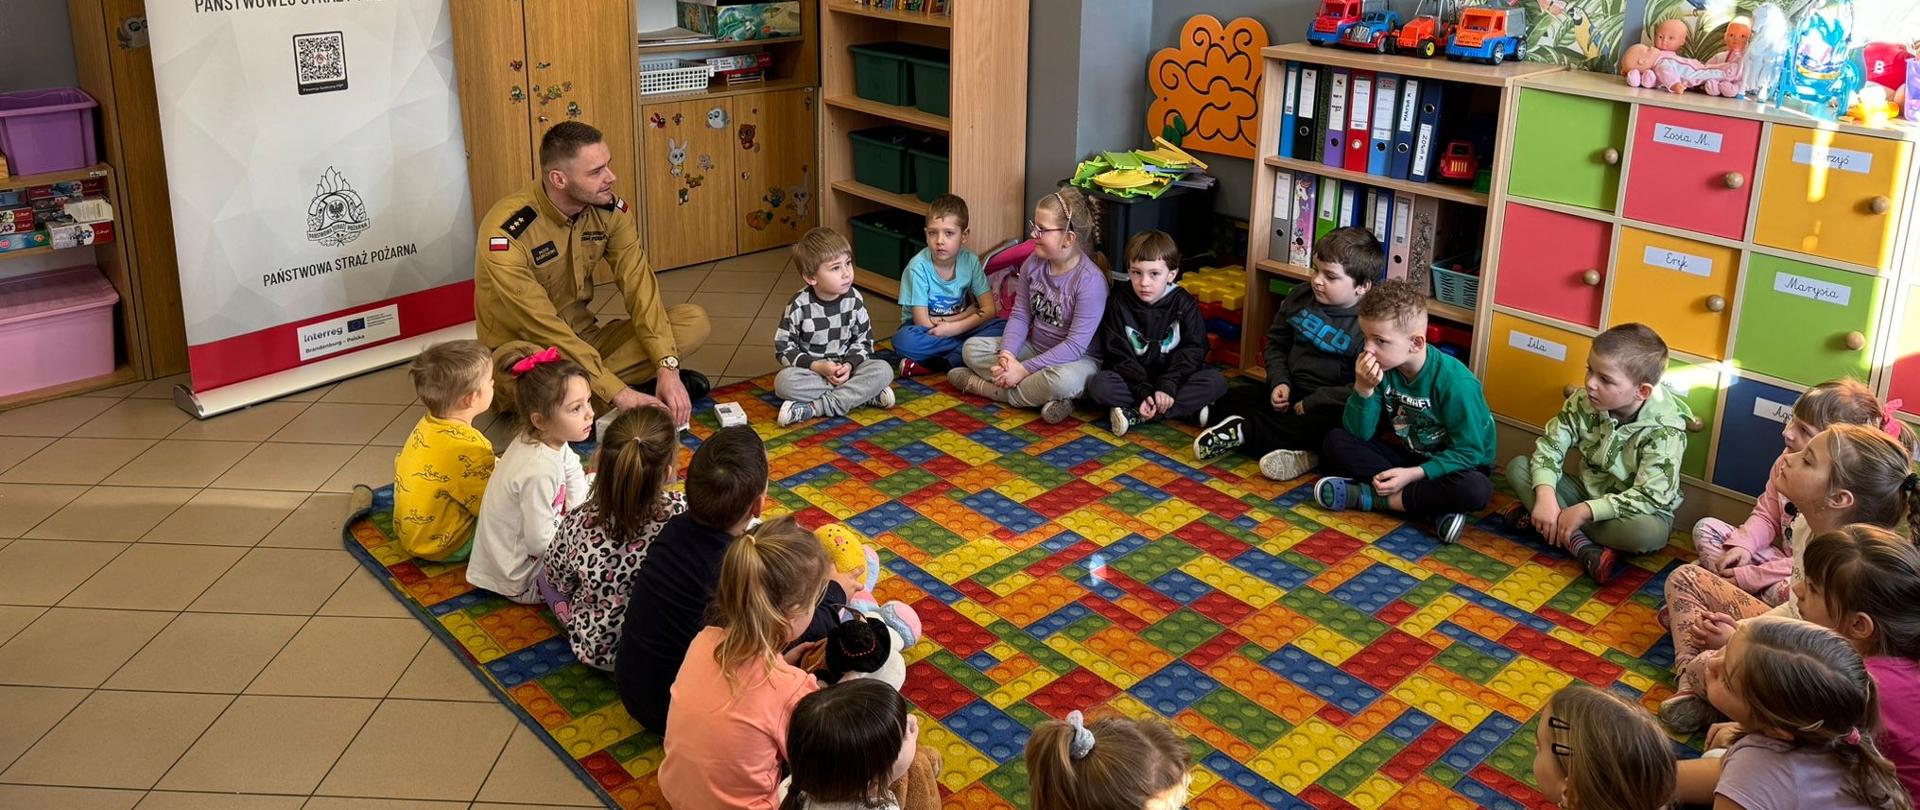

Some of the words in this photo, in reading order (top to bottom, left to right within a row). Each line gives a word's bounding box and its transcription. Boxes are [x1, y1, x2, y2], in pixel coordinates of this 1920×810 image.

[1873, 60, 1885, 74] B
[1664, 127, 1691, 142] Zosia
[263, 261, 333, 287] PAŃSTWOWA
[334, 250, 368, 271] STRAŻ
[370, 243, 417, 263] POŻARNA
[1665, 252, 1688, 271] Eryk
[1784, 277, 1839, 300] Marysia
[1291, 309, 1352, 351] arb
[305, 340, 342, 353] Brandenburg
[346, 335, 365, 343] Polska
